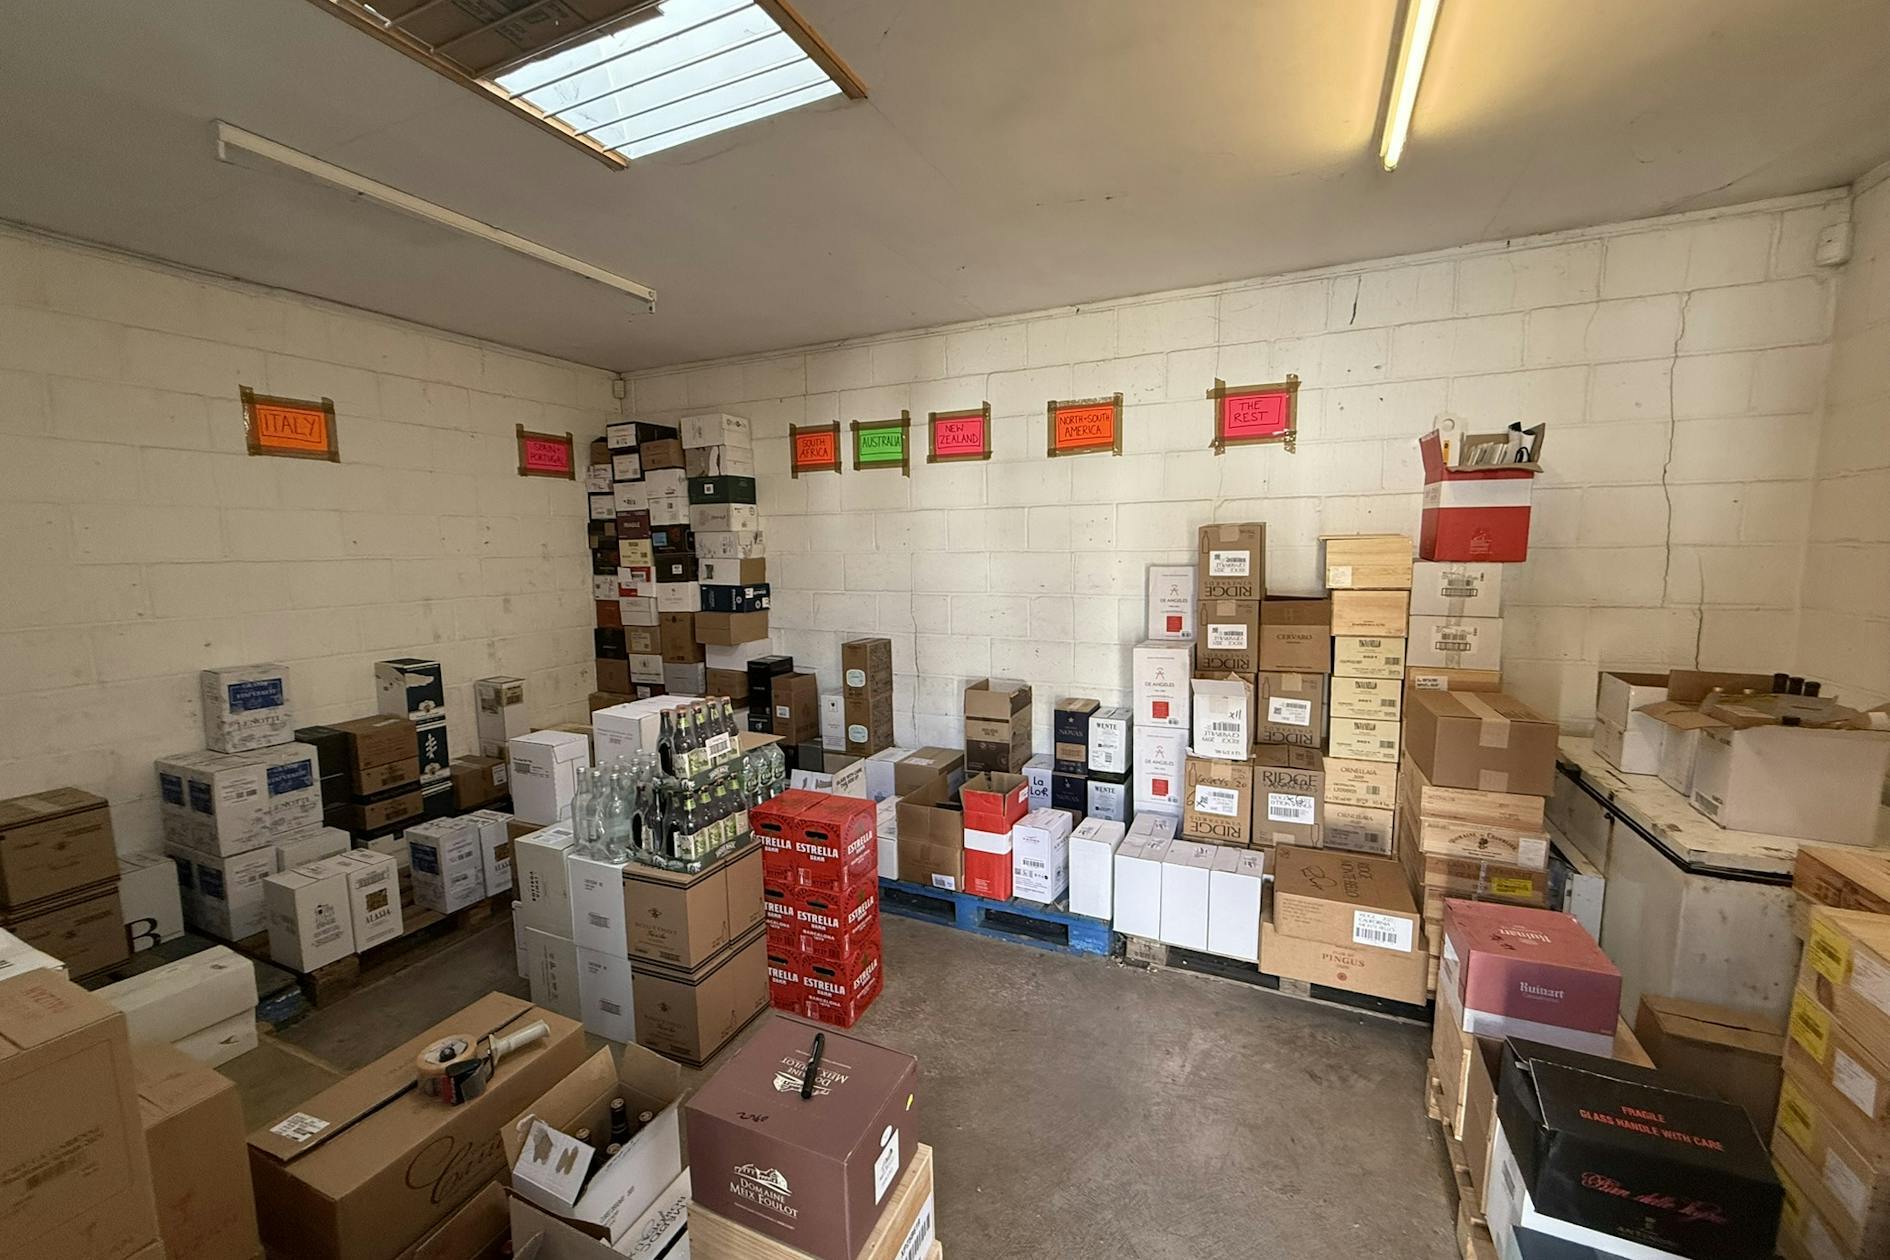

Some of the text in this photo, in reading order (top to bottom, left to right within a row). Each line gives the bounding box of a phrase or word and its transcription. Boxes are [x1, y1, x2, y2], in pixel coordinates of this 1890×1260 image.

[1239, 400, 1260, 411] THE
[263, 412, 317, 438] ITALY
[1233, 411, 1268, 423] REST
[944, 424, 964, 433] NEW
[1064, 424, 1102, 438] AMERICA
[802, 438, 826, 448] SOUTH
[862, 435, 900, 448] AUSTRALIA
[939, 432, 979, 445] ZEALAND
[799, 447, 829, 458] AFRICA
[1204, 586, 1252, 598] RIDGE
[1202, 657, 1250, 670] RIDGE
[1096, 722, 1118, 731] WENTE
[1263, 730, 1313, 745] RIDGE
[1263, 771, 1318, 787] RIDGE
[1094, 786, 1116, 794] WENTE
[1190, 822, 1241, 838] RIDGE
[757, 835, 792, 850] TRELLA
[796, 842, 839, 858] ESTRELLA
[848, 830, 873, 855] ESTRELLA
[764, 901, 794, 916] TRELLA
[848, 896, 874, 924] ESTRELLA
[797, 910, 839, 928] ESTRELLA
[1322, 952, 1366, 968] PINGUS
[767, 966, 799, 982] TRELLA
[853, 958, 878, 990] ESTRELLA
[803, 977, 846, 995] ESTRELLA
[1519, 981, 1565, 999] Ruinart
[1621, 1105, 1667, 1123] FRAGILE
[1579, 1109, 1725, 1152] GLASS HANDLE WITH CARE
[740, 1178, 785, 1203] DOMAINE
[730, 1181, 799, 1217] MEIX FOULOT
